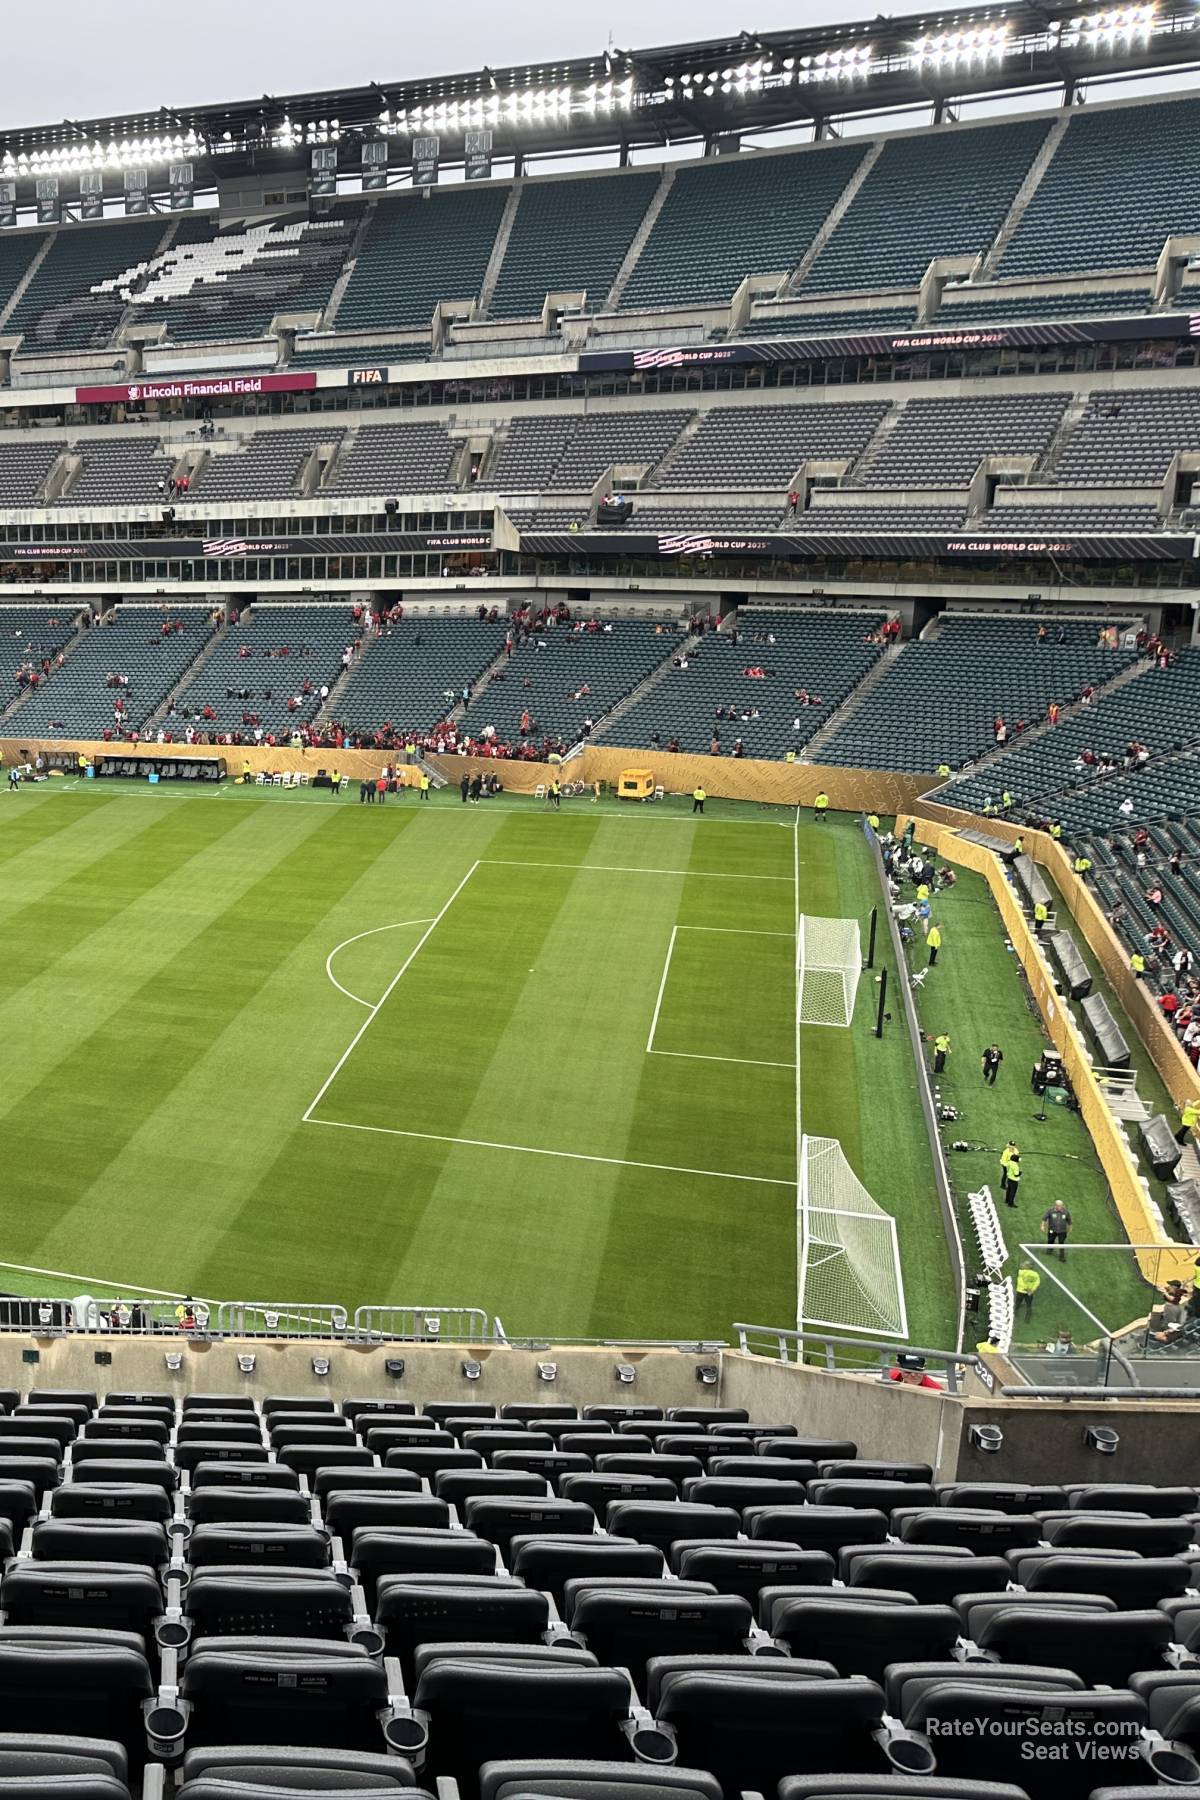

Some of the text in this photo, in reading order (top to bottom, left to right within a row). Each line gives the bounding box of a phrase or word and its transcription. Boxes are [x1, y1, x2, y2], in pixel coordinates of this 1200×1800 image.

[314, 149, 336, 170] 15
[353, 370, 382, 384] FIFA
[143, 379, 262, 398] Lincoln Financial Field
